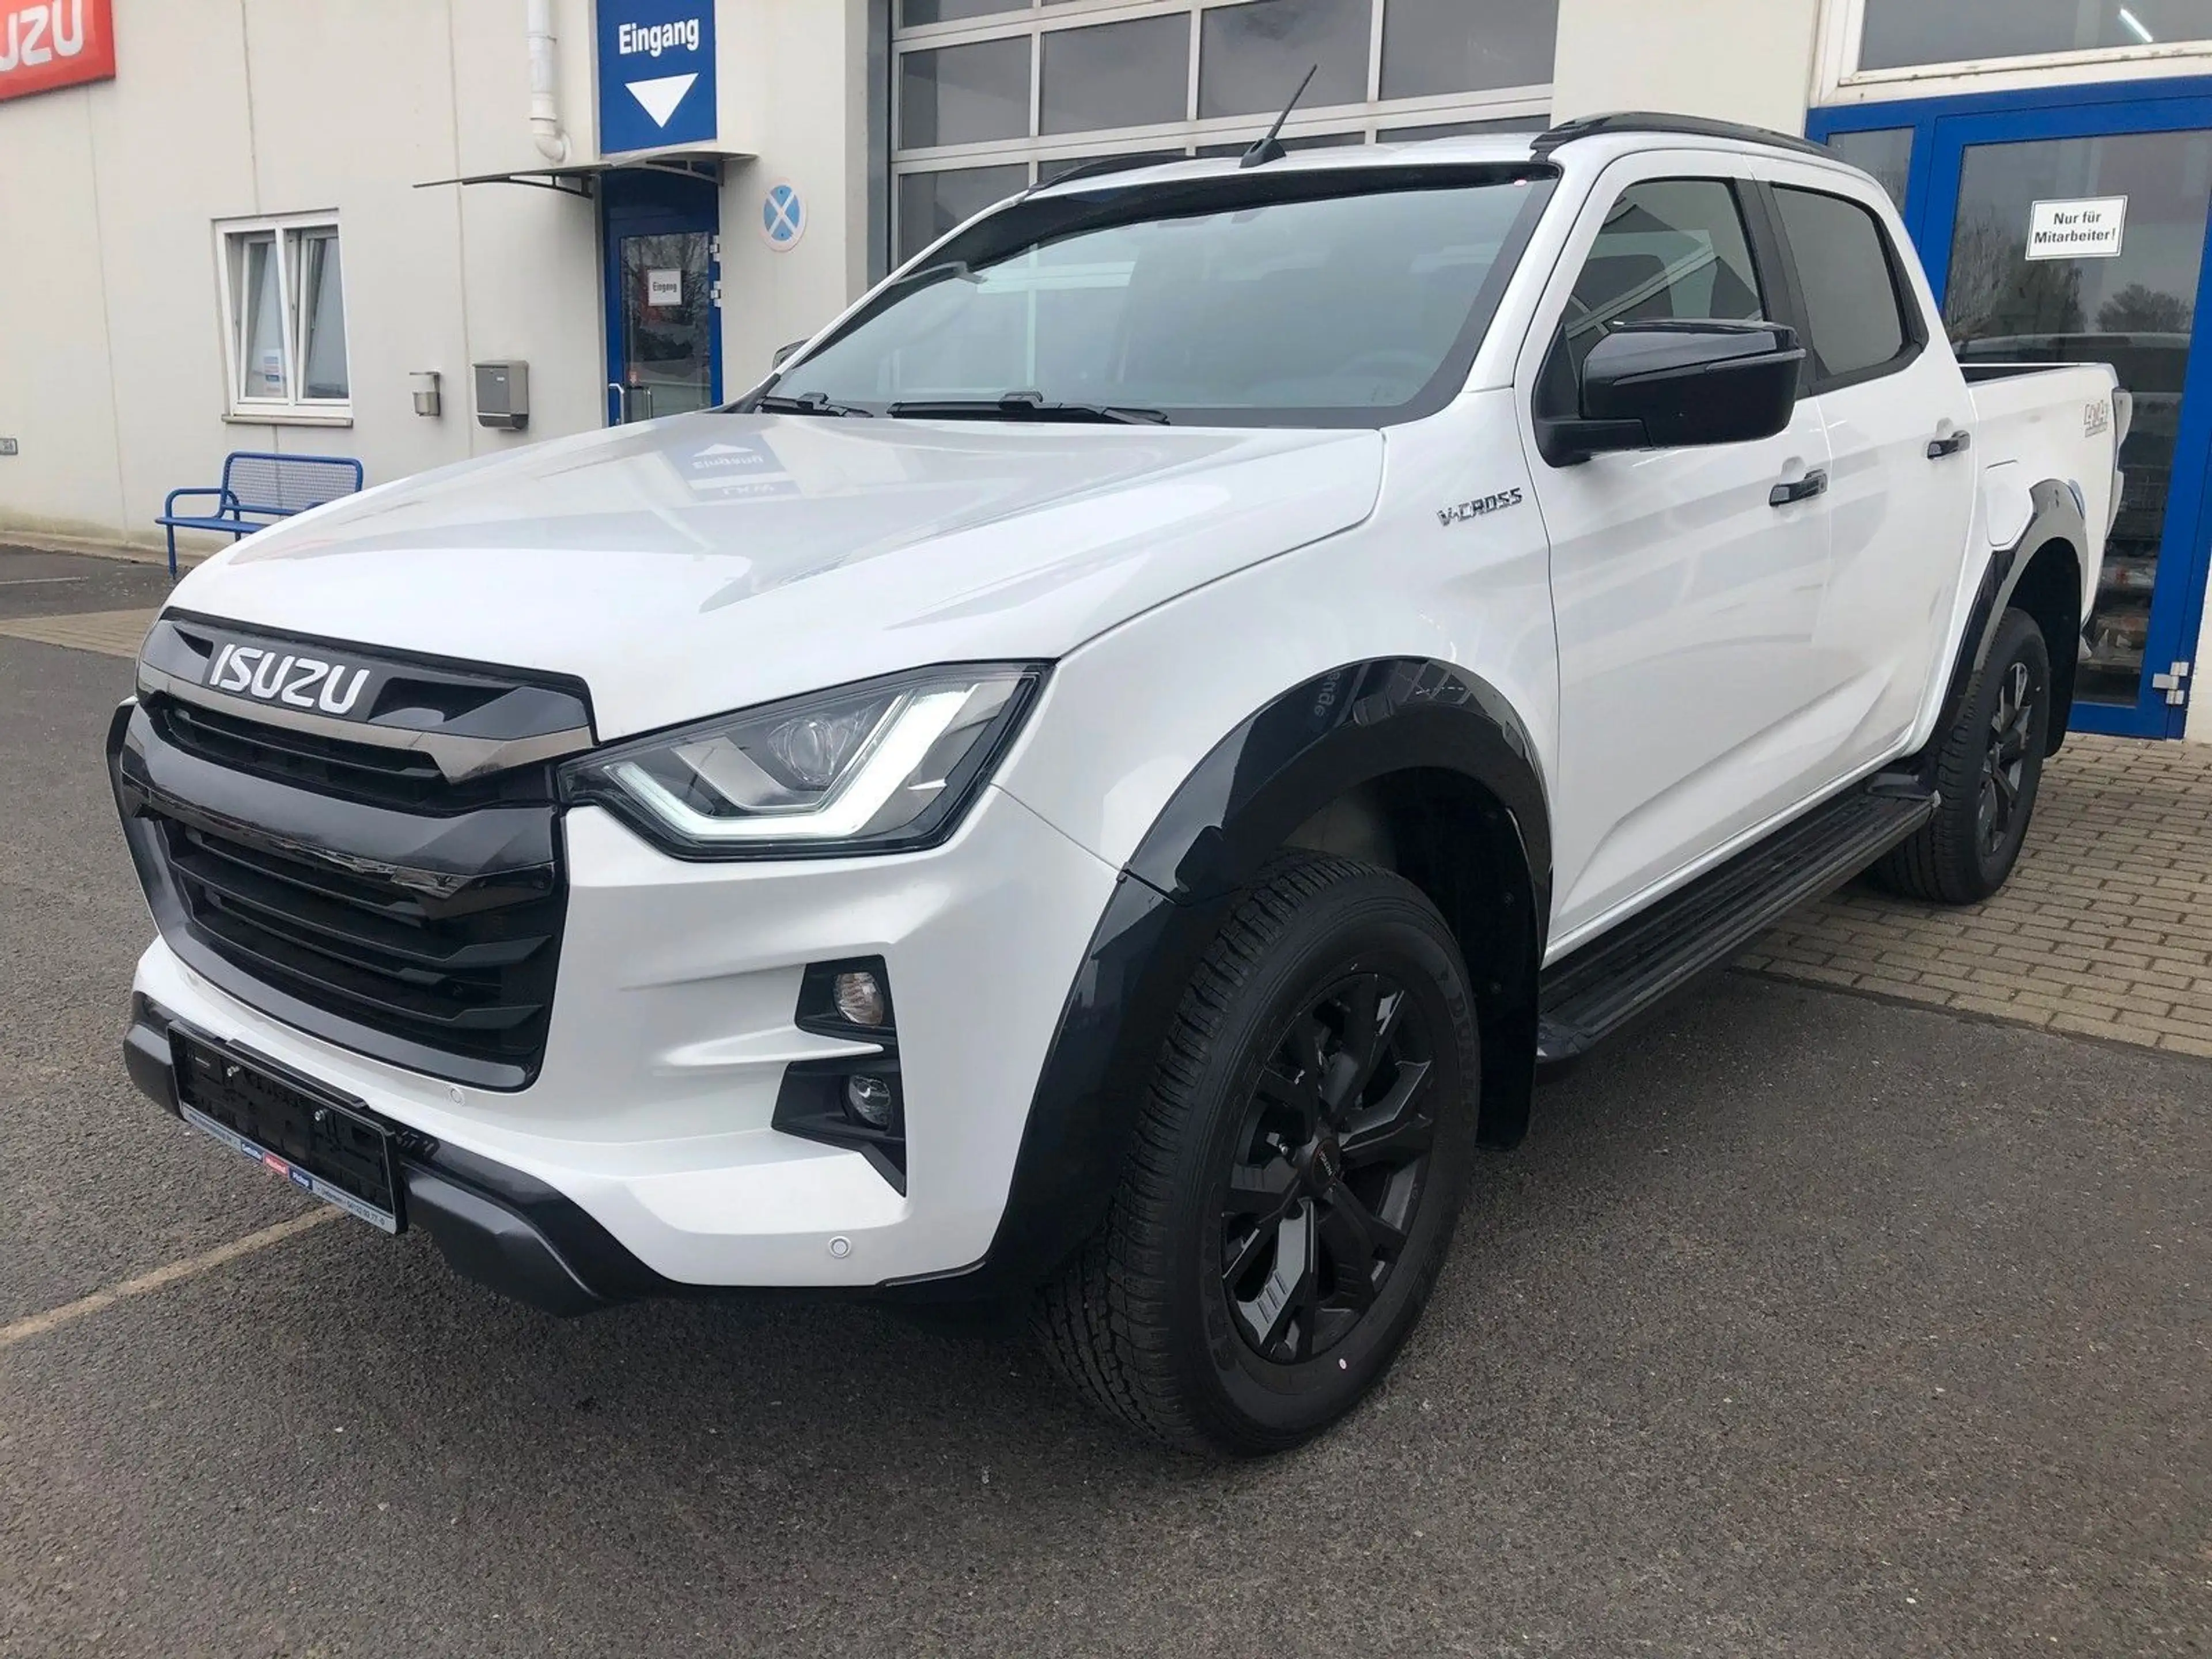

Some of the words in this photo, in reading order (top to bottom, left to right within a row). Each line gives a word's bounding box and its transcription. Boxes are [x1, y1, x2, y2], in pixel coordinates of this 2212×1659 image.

[619, 18, 699, 58] Eingang
[2034, 228, 2116, 244] Mitarbeiter!
[2054, 213, 2079, 225] Nur
[2082, 211, 2102, 224] für
[1437, 487, 1522, 526] V-CROSS
[209, 643, 370, 714] ISUZU
